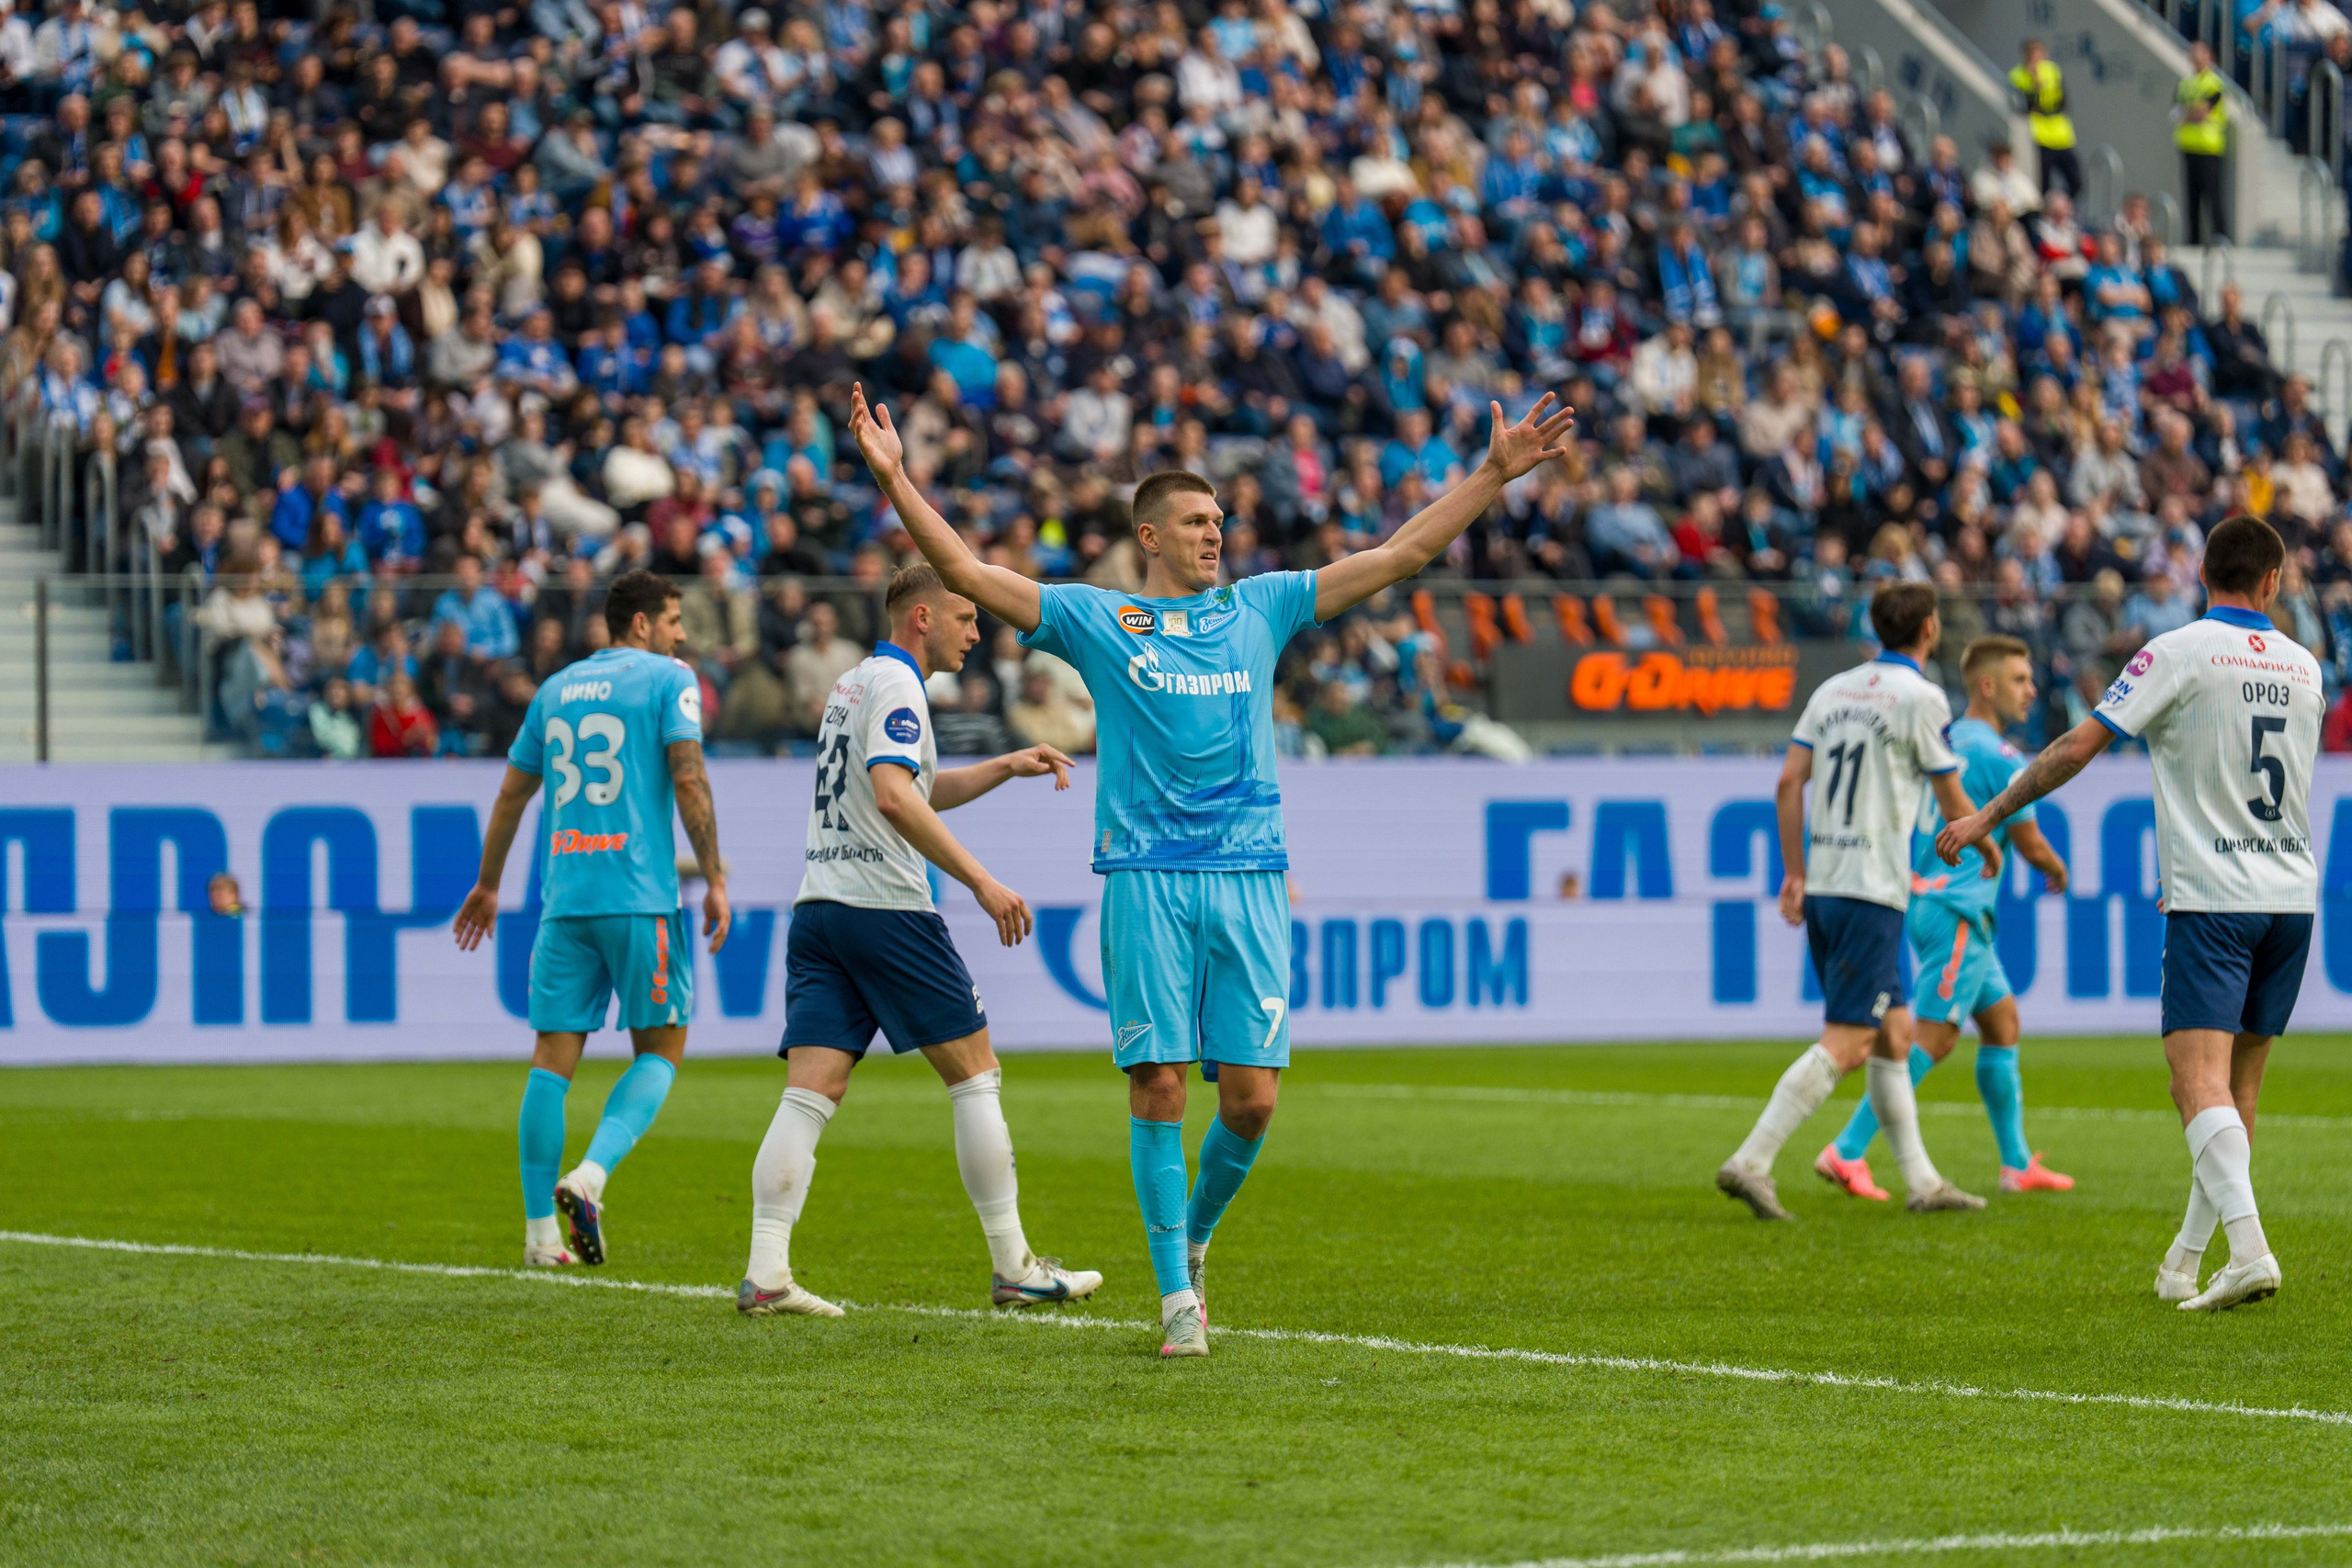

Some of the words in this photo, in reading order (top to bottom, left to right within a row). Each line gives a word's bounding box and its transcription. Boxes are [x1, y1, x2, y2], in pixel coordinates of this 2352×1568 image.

[1126, 616, 1153, 626] WIN
[2211, 654, 2309, 676] СОЛИДАРНОСТЬ
[560, 681, 612, 705] НИНО
[1166, 671, 1251, 695] ГАЗПРОМ
[2243, 682, 2290, 705] ОРОЗ
[545, 712, 626, 811] 33
[2247, 716, 2287, 821] 5
[1827, 740, 1865, 826] 11
[1261, 997, 1284, 1048] 7
